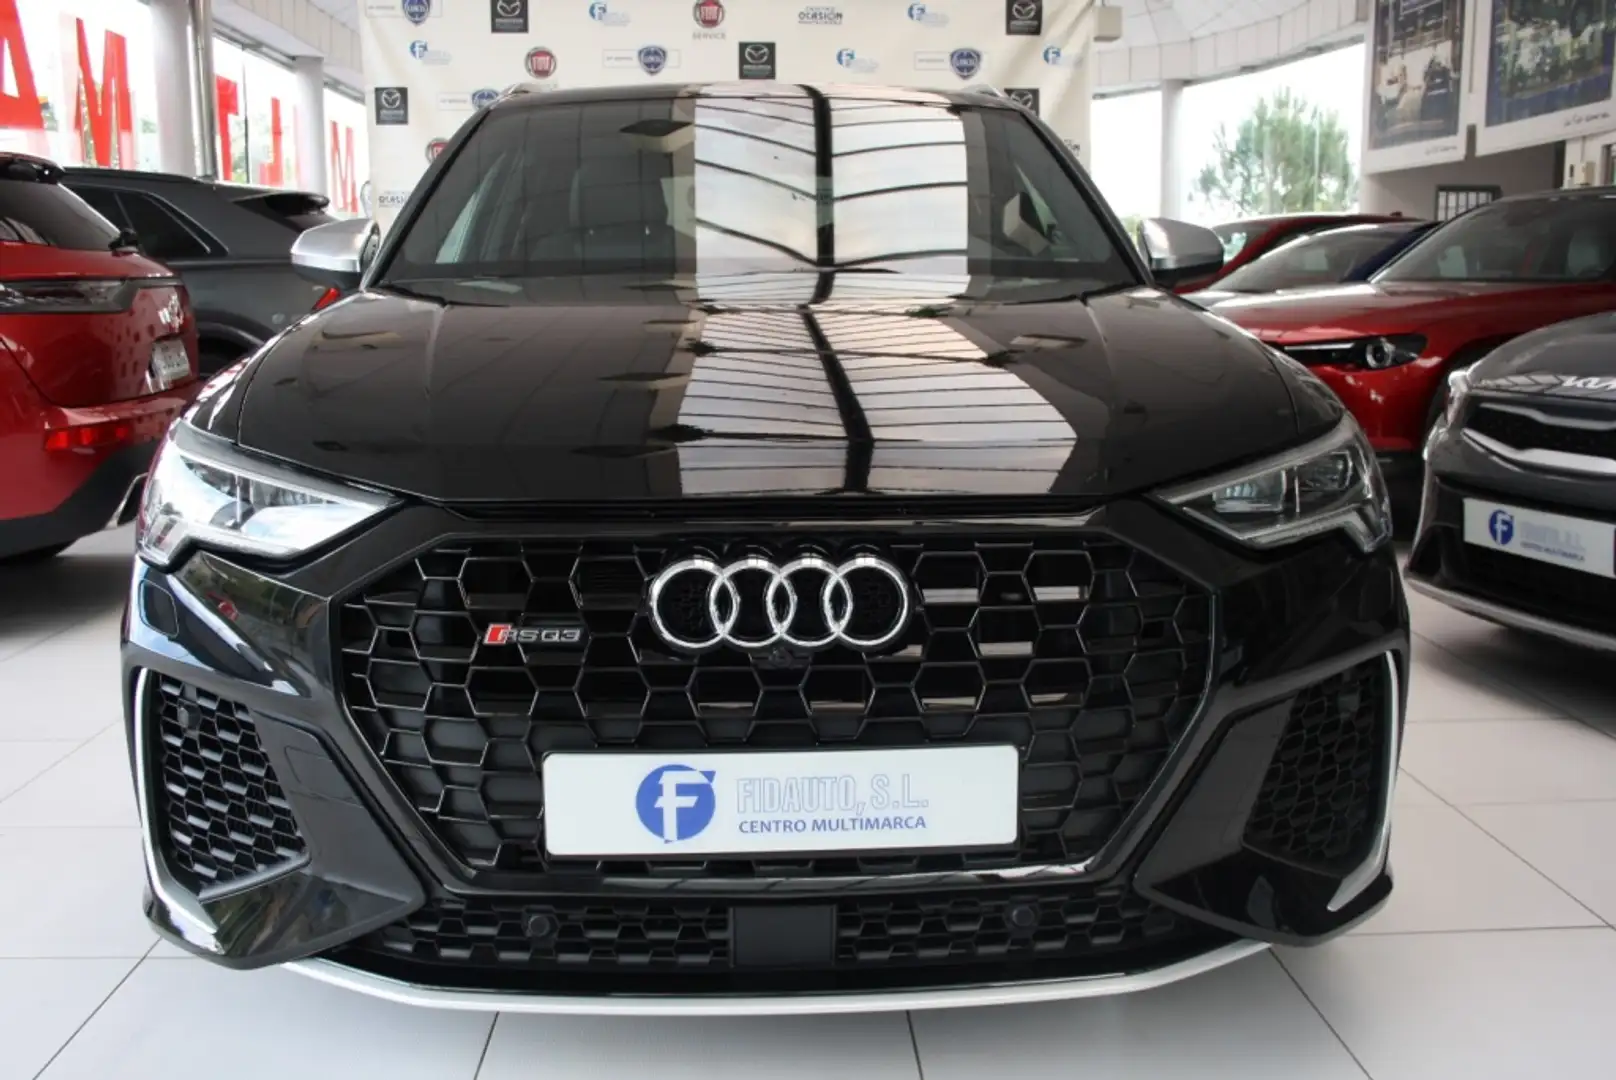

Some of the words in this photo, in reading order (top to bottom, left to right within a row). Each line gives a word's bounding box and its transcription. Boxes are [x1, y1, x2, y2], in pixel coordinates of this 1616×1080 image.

[737, 775, 866, 816] FIDAUTO,
[871, 774, 930, 810] S.L.
[739, 819, 806, 834] CENTRO
[811, 816, 926, 832] MULTIMARCA
